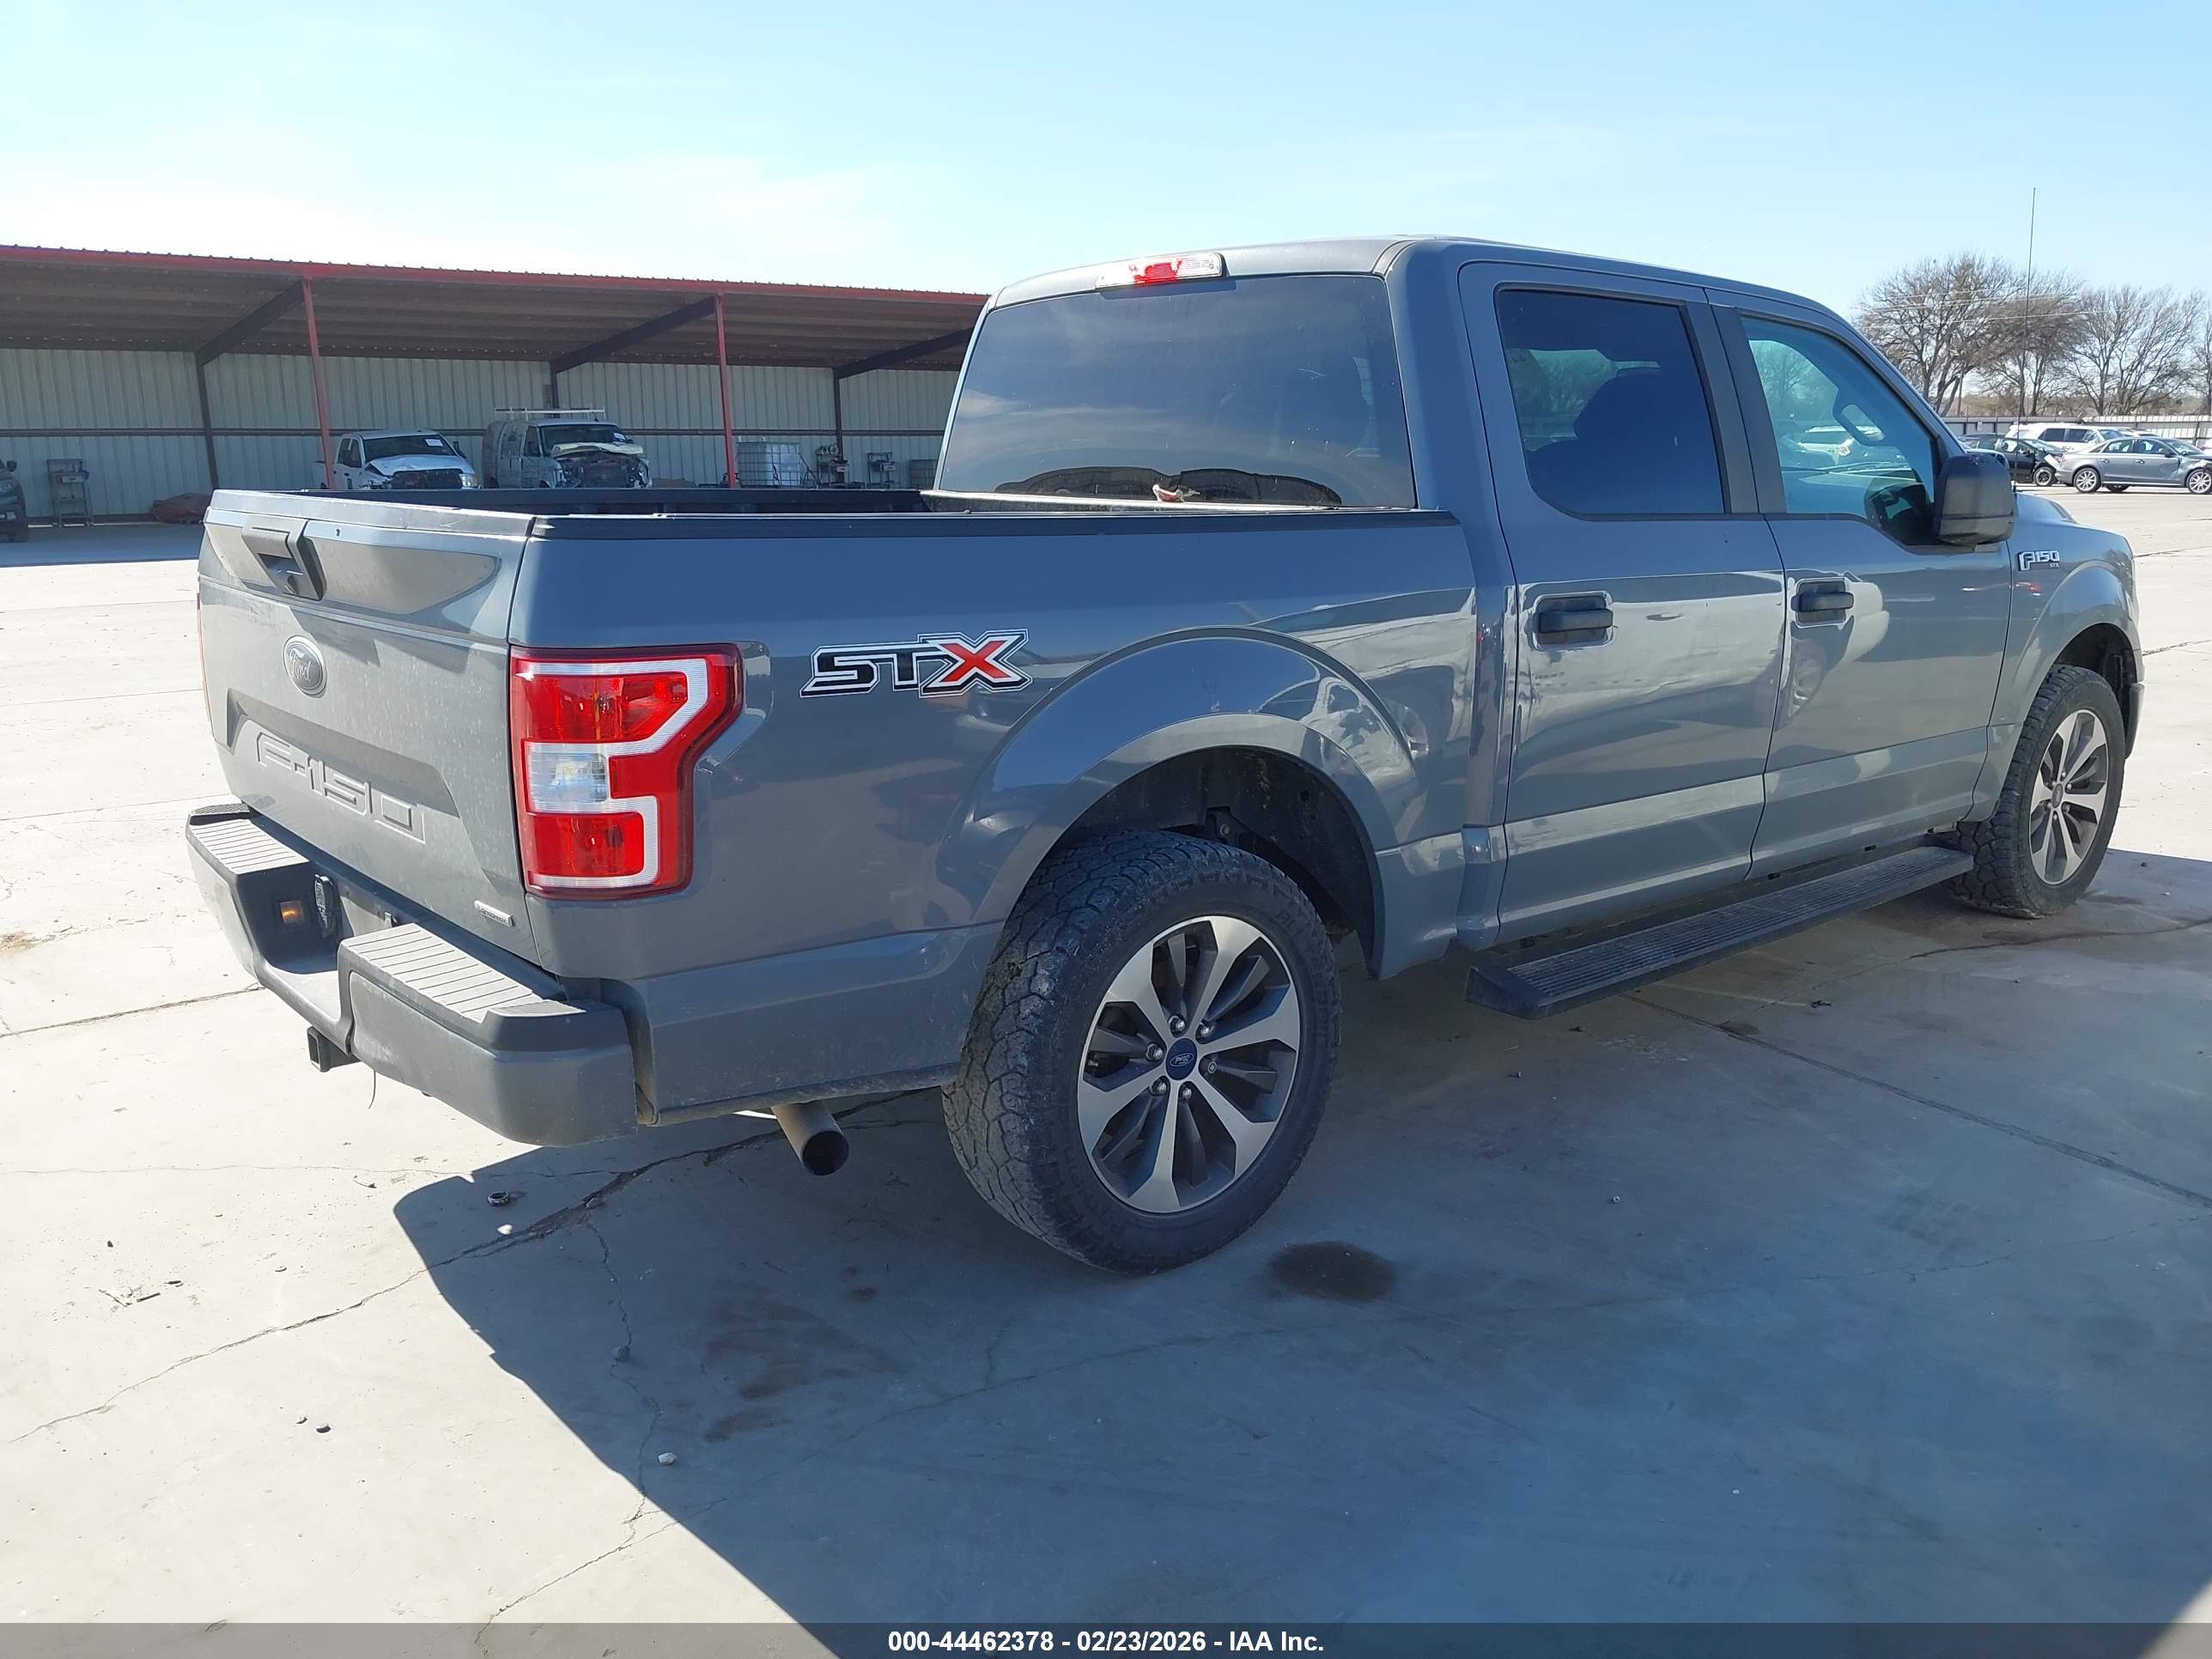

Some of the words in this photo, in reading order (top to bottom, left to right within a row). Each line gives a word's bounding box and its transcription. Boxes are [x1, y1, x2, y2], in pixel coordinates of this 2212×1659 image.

[288, 647, 313, 683] Ford
[800, 629, 1033, 698] STX
[256, 732, 426, 844] F-150
